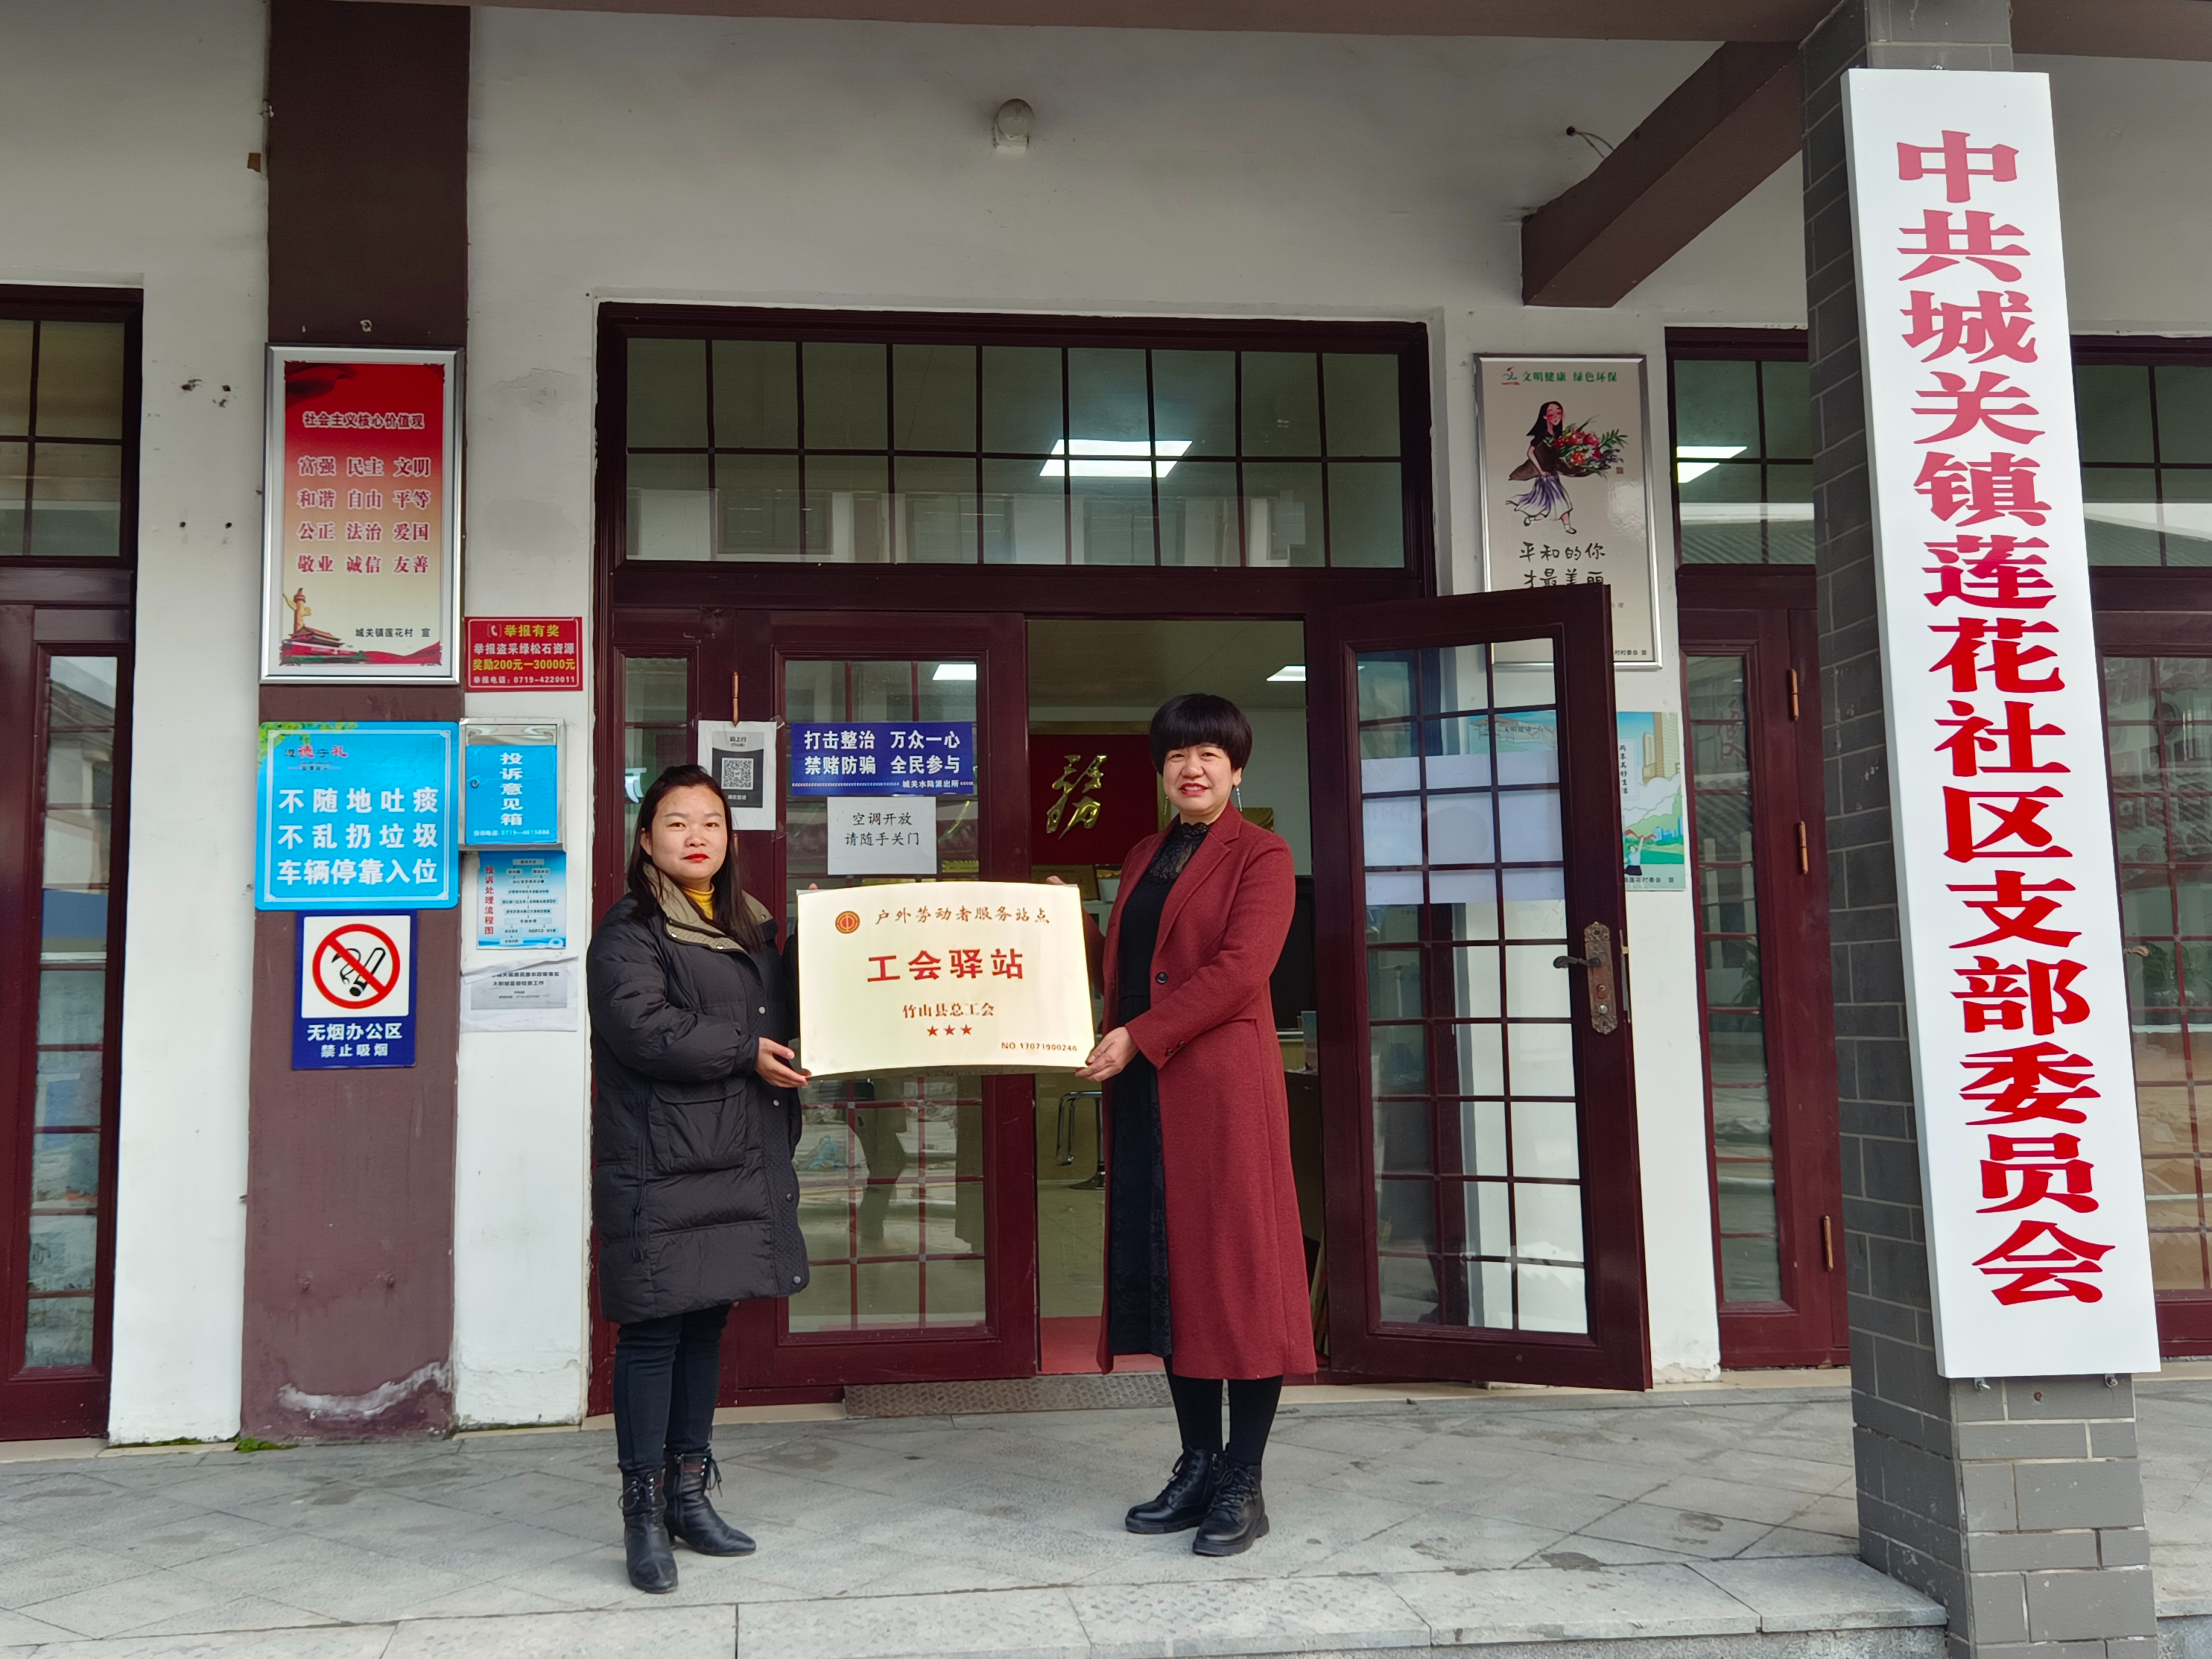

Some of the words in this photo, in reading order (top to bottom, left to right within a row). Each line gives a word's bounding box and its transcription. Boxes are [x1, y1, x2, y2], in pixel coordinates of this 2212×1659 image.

[1522, 371, 1566, 381] 文明健康
[1574, 371, 1617, 382] 绿色环保
[302, 411, 425, 430] 社会主义核心价值观
[299, 456, 336, 475] 富强
[346, 457, 384, 476] 民主
[393, 457, 431, 477] 文明
[298, 489, 335, 508] 和谐
[347, 489, 382, 508] 自由
[393, 489, 431, 510] 平等
[298, 521, 335, 541] 公正
[346, 522, 383, 542] 法治
[393, 522, 430, 542] 爱国
[1519, 542, 1606, 562] 平和的你
[297, 554, 334, 573] 敬业
[346, 555, 382, 574] 诚信
[393, 555, 429, 574] 友善
[355, 628, 413, 638] 城关镇莲花村
[421, 628, 431, 638] 宣
[504, 624, 560, 637] 举报有奖
[473, 642, 575, 655] 举报盗采绿松石资源
[1896, 129, 2116, 1305] 中共城关镇莲花社区支部委员会
[804, 730, 875, 749] 打击整治
[890, 730, 960, 749] 万众一心
[804, 755, 876, 775] 禁赌防骗
[890, 755, 960, 774] 全民参与
[499, 752, 524, 826] 投诉意见箱
[902, 780, 959, 788] 城关水陆派出所
[279, 787, 439, 813] 不随地吐痰
[852, 812, 913, 826] 空调开放
[278, 822, 438, 849] 不乱扔垃圾
[844, 832, 919, 846] 请随手关门
[277, 858, 438, 885] 车辆停靠入位
[484, 866, 495, 935] 投诉处理流程图
[875, 905, 1050, 925] 户外劳动者服务站点
[866, 948, 1024, 983] 工会驿站
[902, 1002, 995, 1018] 竹山县总工会
[307, 1022, 402, 1041] 无烟办公区
[320, 1043, 388, 1058] 禁止吸烟
